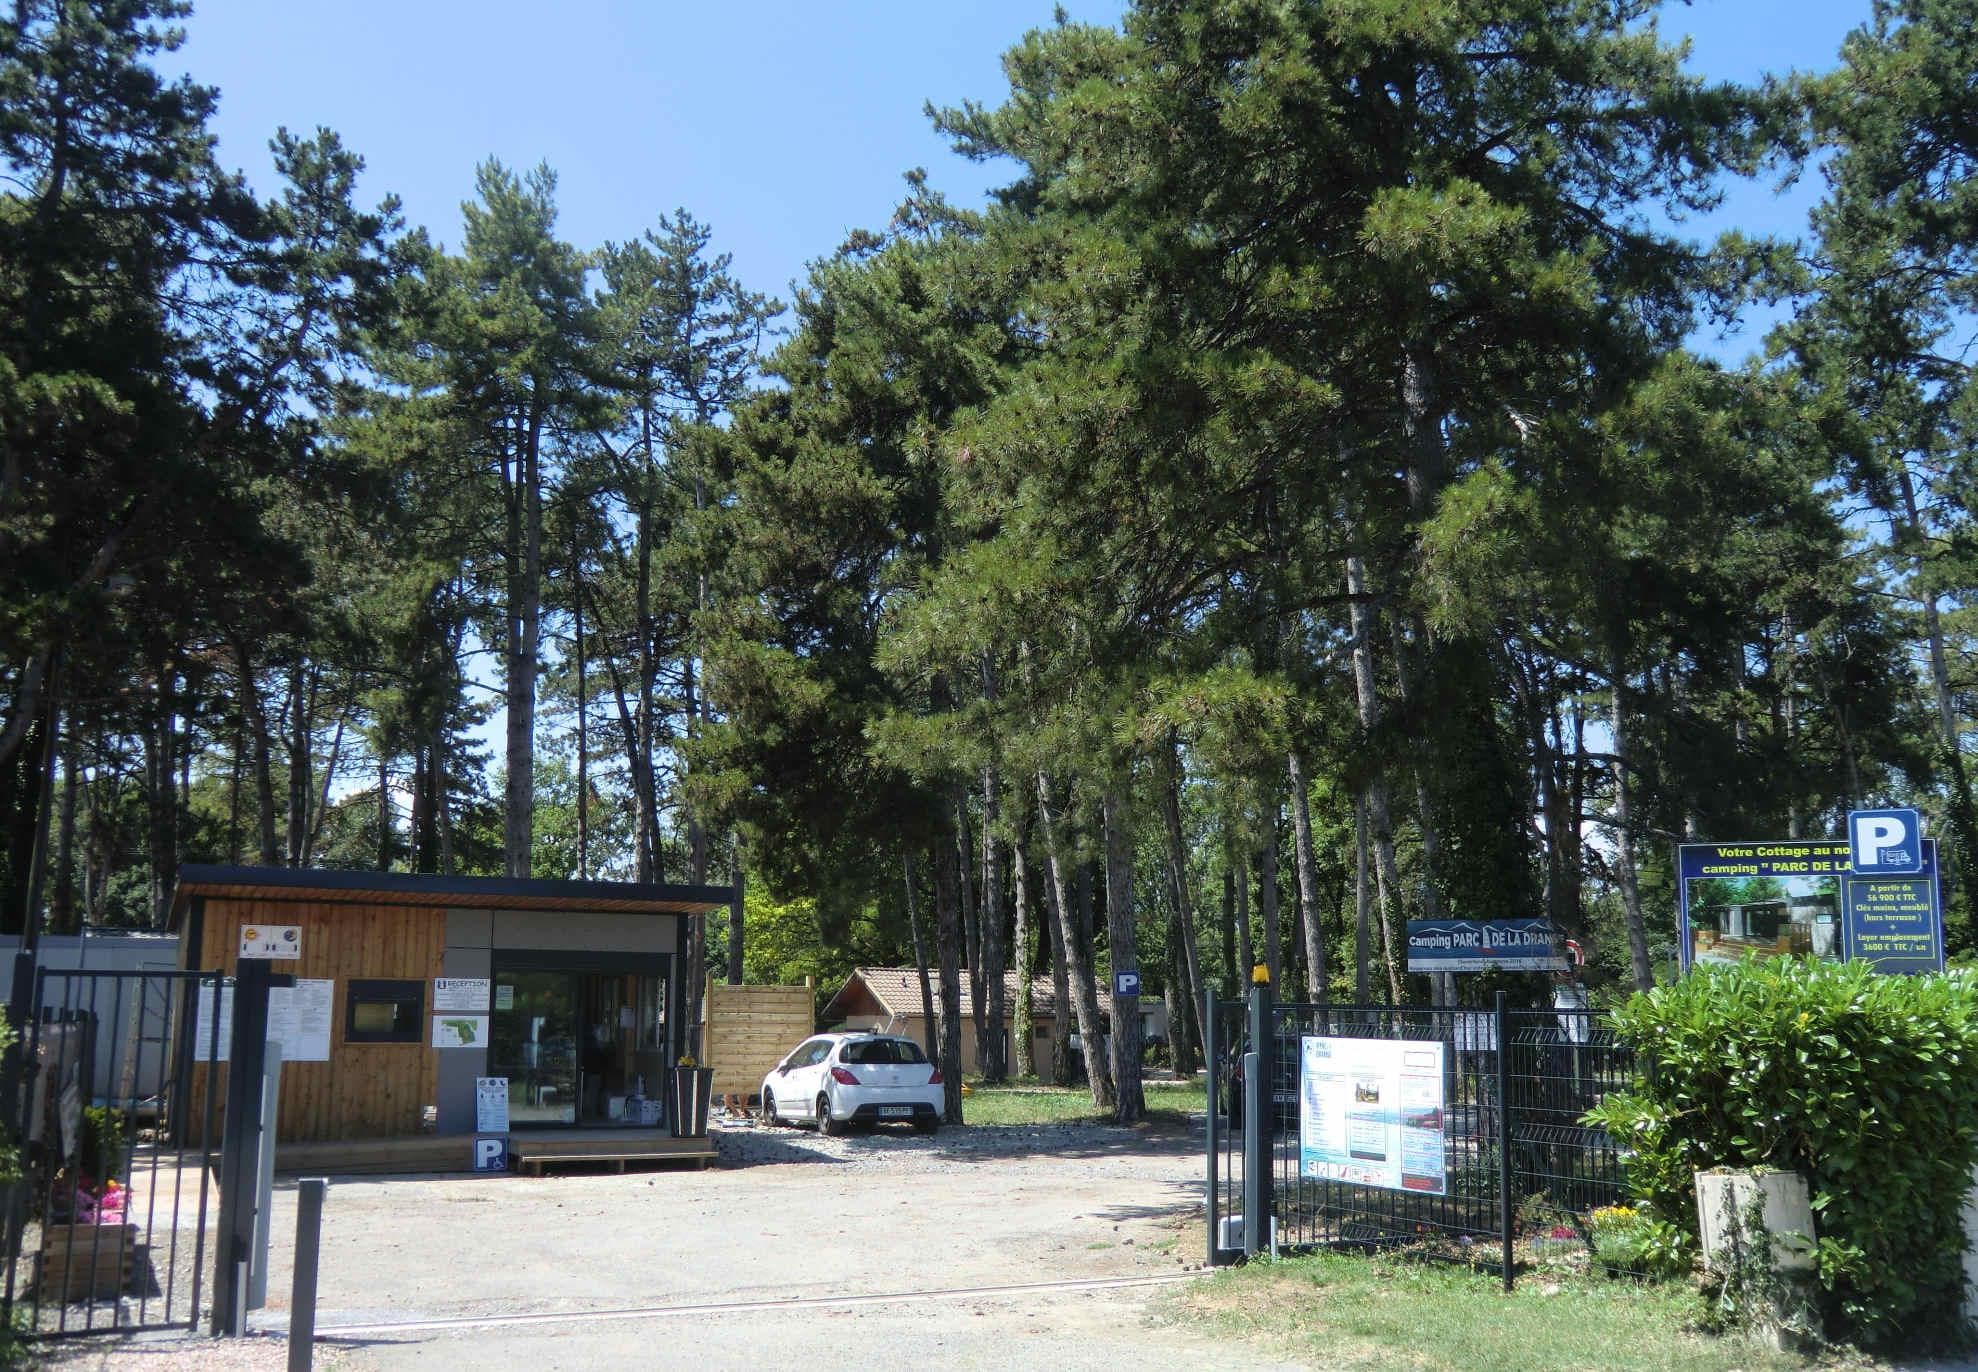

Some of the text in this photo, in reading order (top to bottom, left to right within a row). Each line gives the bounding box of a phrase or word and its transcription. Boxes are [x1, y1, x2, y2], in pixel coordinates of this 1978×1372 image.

[1856, 817, 1906, 865] P
[1717, 847, 1851, 858] Votre Cottage au no
[1702, 864, 1758, 875] camping
[1772, 862, 1808, 872] PARC
[1812, 861, 1831, 871] DE
[1835, 861, 1852, 870] LA
[1878, 884, 1900, 892] partir
[1409, 931, 1558, 949] Camping PARC DE LA DRAN
[1119, 974, 1138, 992] P
[478, 1140, 502, 1168] P
